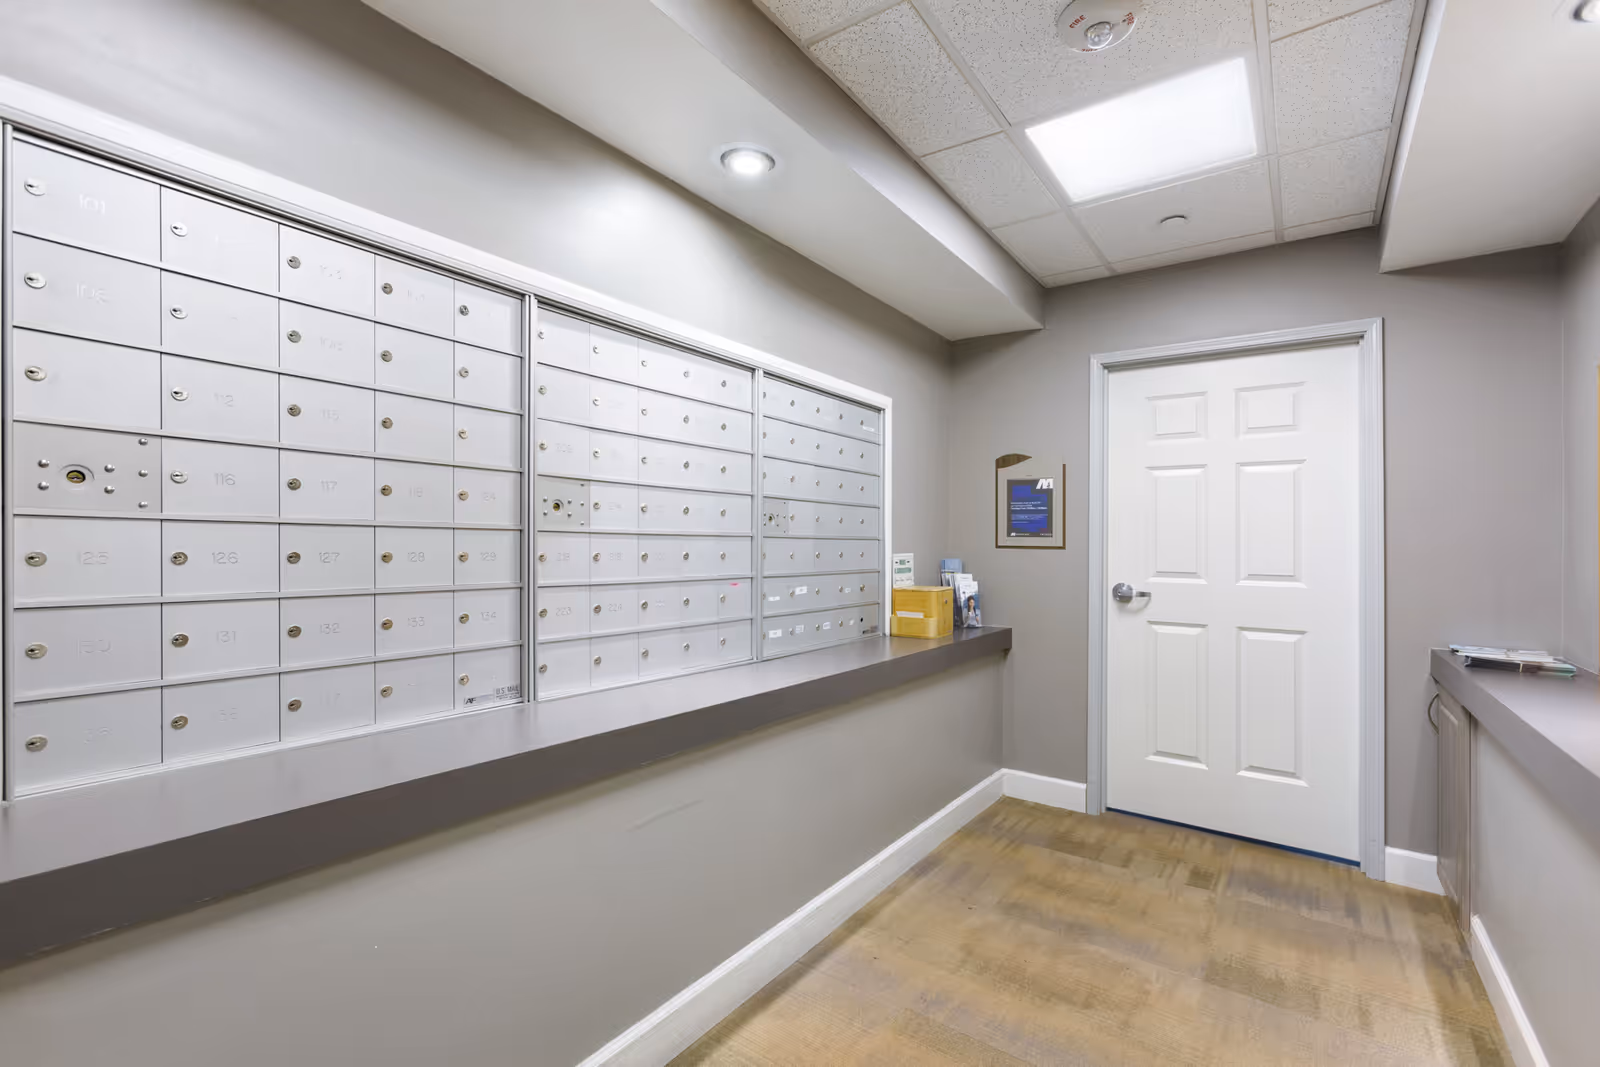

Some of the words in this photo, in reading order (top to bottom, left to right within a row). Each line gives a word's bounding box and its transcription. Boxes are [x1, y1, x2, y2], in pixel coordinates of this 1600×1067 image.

[1069, 15, 1086, 29] FIRE
[214, 472, 236, 487] 116
[77, 551, 110, 566] 125
[211, 551, 239, 566] 126
[318, 551, 341, 565] 127
[407, 551, 426, 563] 128
[319, 622, 341, 636] 132
[407, 616, 425, 628] 133
[216, 629, 237, 646] 131
